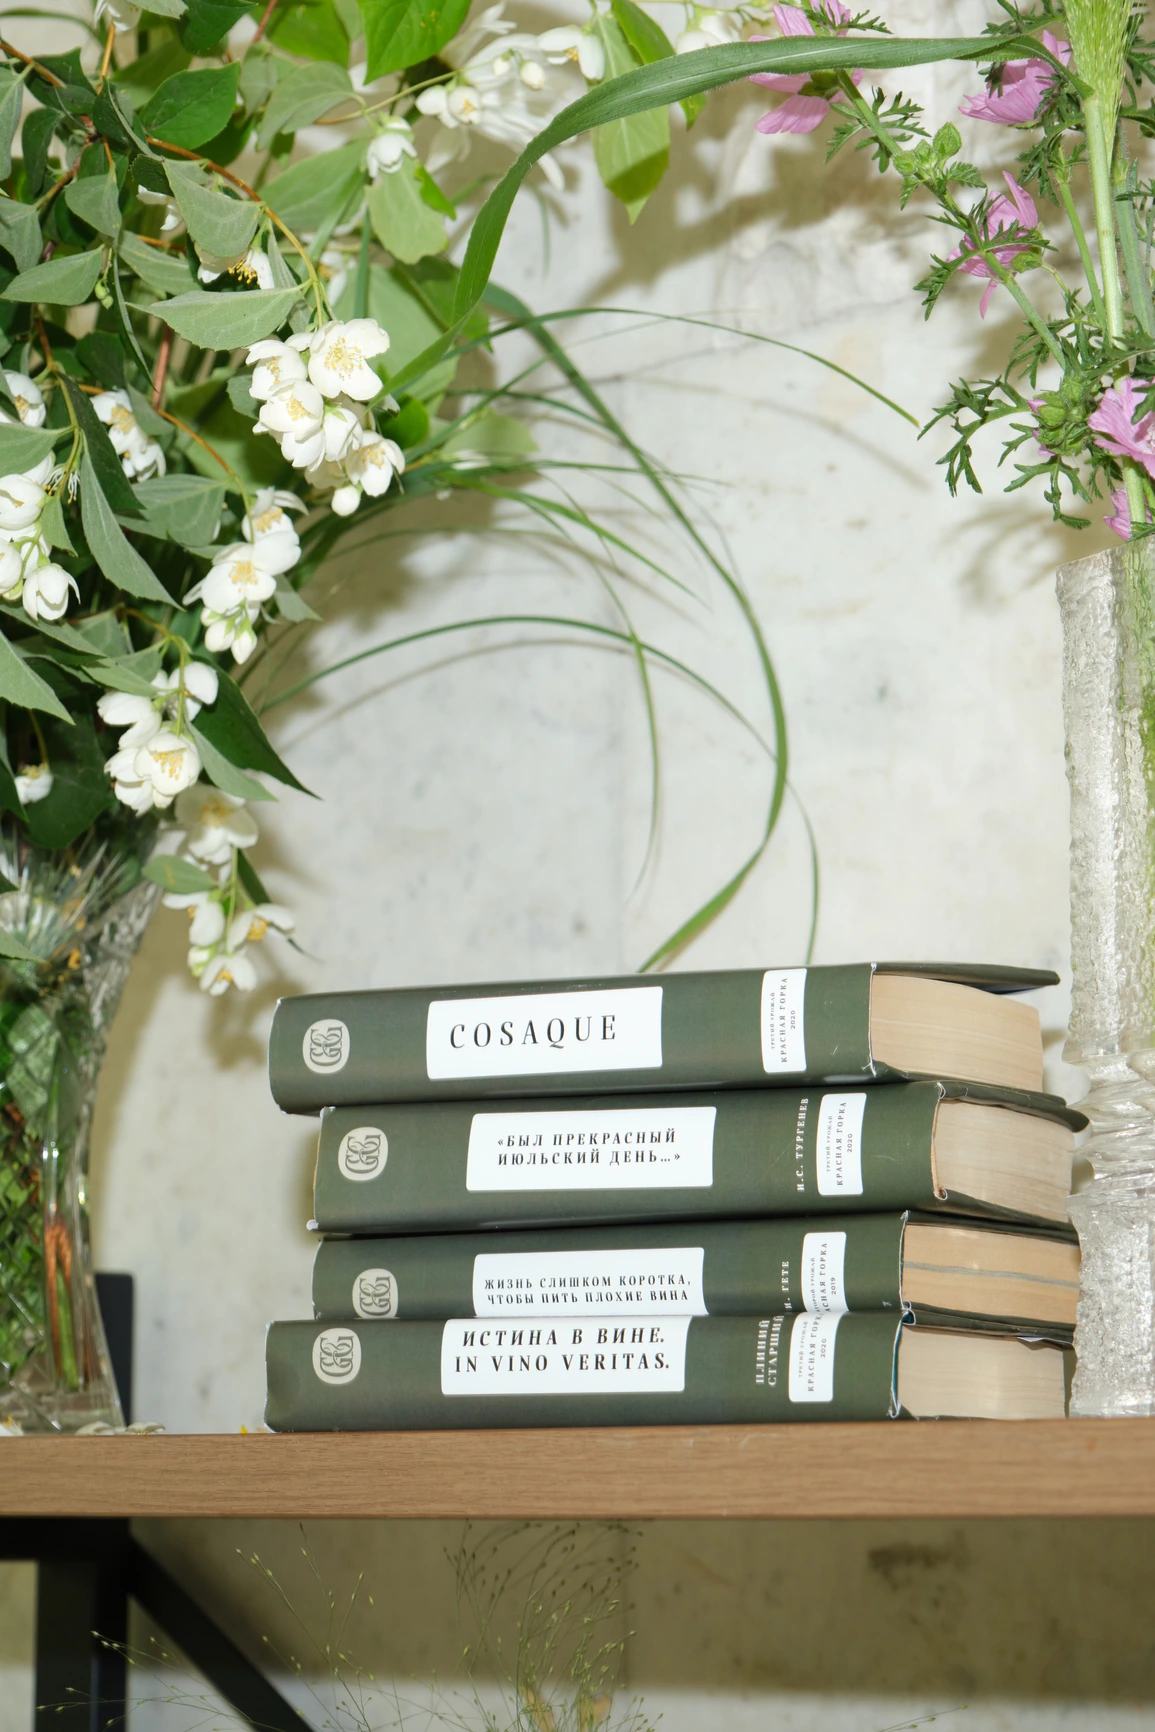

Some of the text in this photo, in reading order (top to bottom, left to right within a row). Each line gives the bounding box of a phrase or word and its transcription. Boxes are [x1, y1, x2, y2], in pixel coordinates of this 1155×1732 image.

[448, 1014, 618, 1050] COSAQUE
[779, 977, 788, 1063] КРАСНАЯ ГОРКА
[497, 1127, 676, 1148] «БЫЛ ПРЕКРАСНЫЙ
[795, 1098, 809, 1192] И.С. ТУРГЕНЕВ
[835, 1101, 847, 1186] КРАСНАЯ ГОРКА
[498, 1148, 601, 1166] ИЮЛЬСКИЙ
[819, 1243, 828, 1276] ГОРКА
[484, 1273, 692, 1290] ЖИЗНЬ СЛИШКОМ КОРОТКА,
[781, 1261, 789, 1292] ГЕТЕ
[486, 1289, 689, 1305] ЧТОБЫ ПИТЬ ПЛОХИЕ ВИНА
[462, 1327, 665, 1347] ИСТИНА В ВИНЕ.
[755, 1320, 770, 1384] ПЛИНИЙ
[767, 1315, 784, 1387] СТАРШИЙ
[455, 1352, 670, 1373] IN VINO VERITAS.
[807, 1343, 816, 1392] КРАСНАЯ
